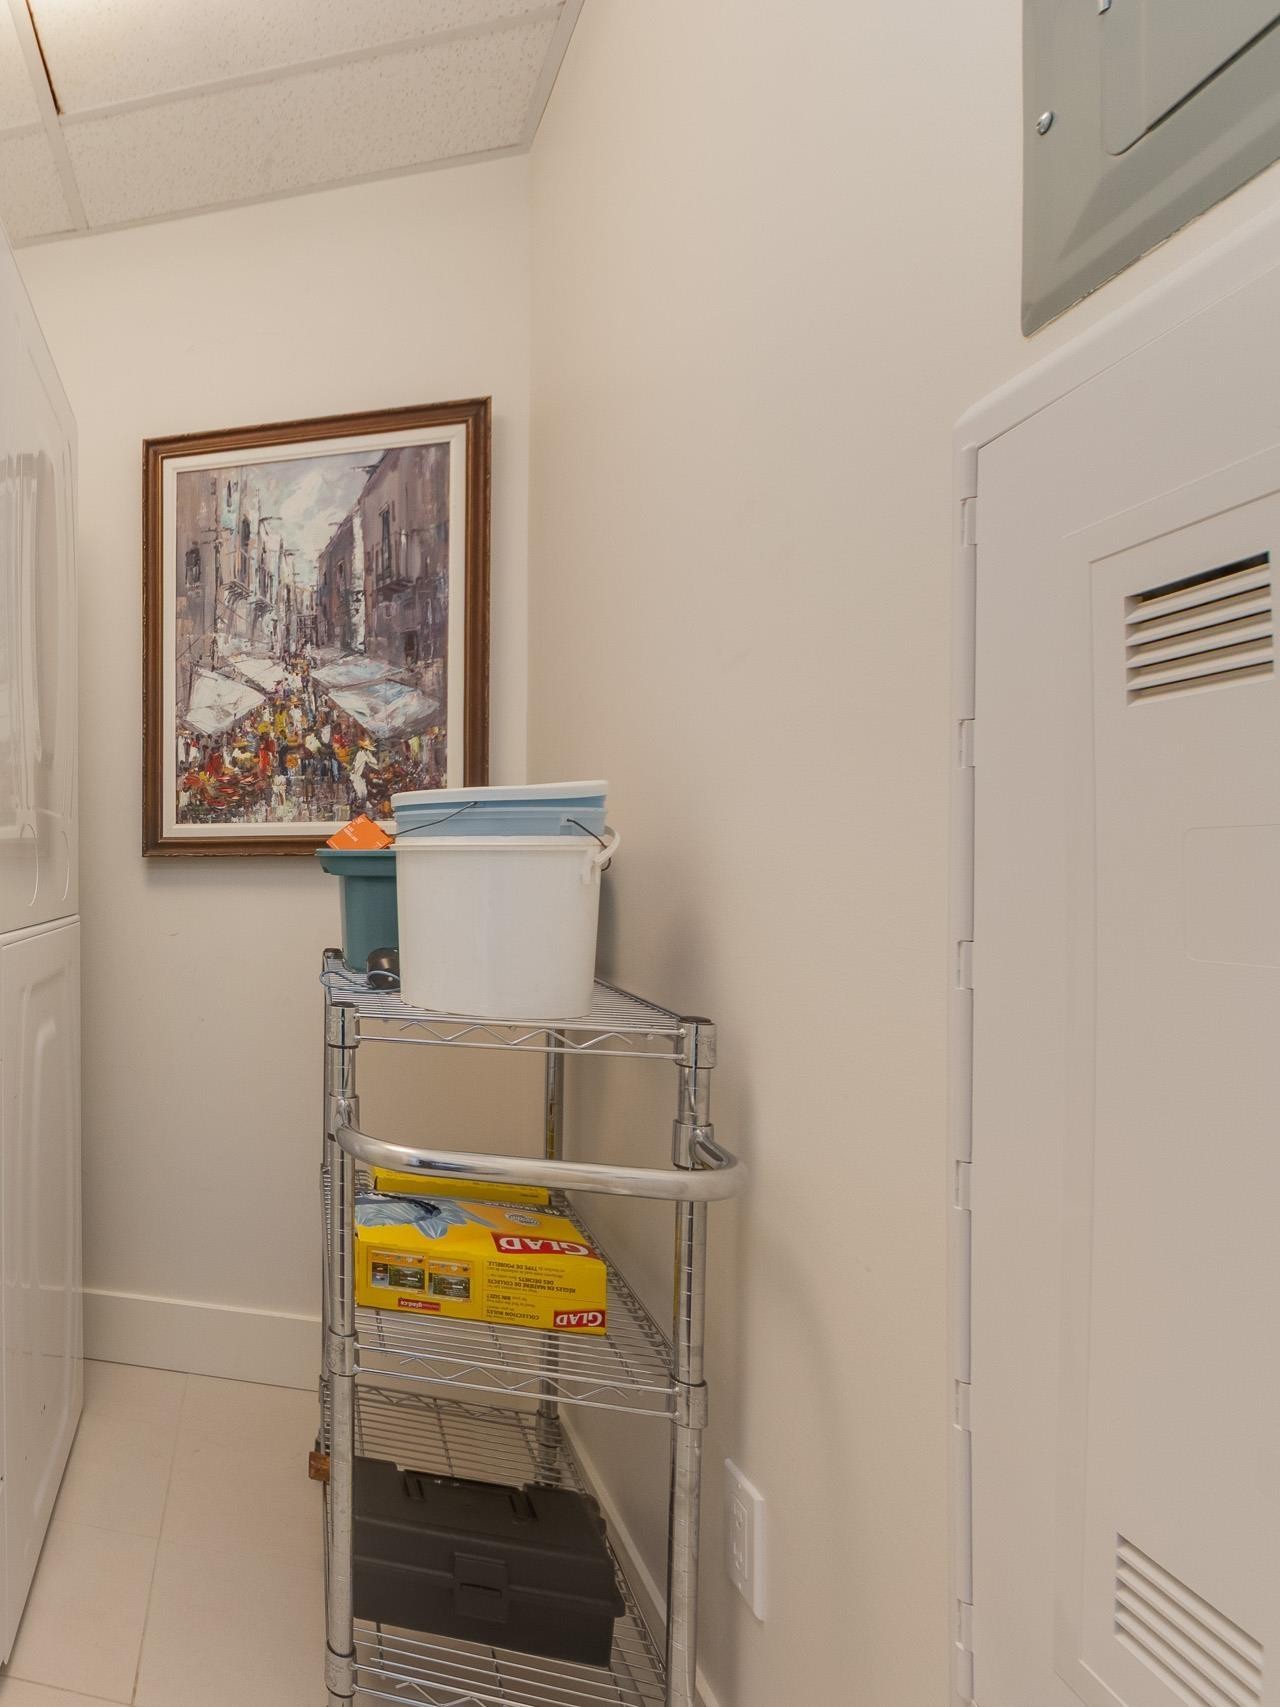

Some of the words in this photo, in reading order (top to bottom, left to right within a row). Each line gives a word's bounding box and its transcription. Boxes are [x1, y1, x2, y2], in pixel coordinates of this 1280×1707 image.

[499, 1237, 589, 1256] GLAD
[505, 1311, 539, 1320] COLLECTION
[556, 1311, 603, 1326] GLAD
